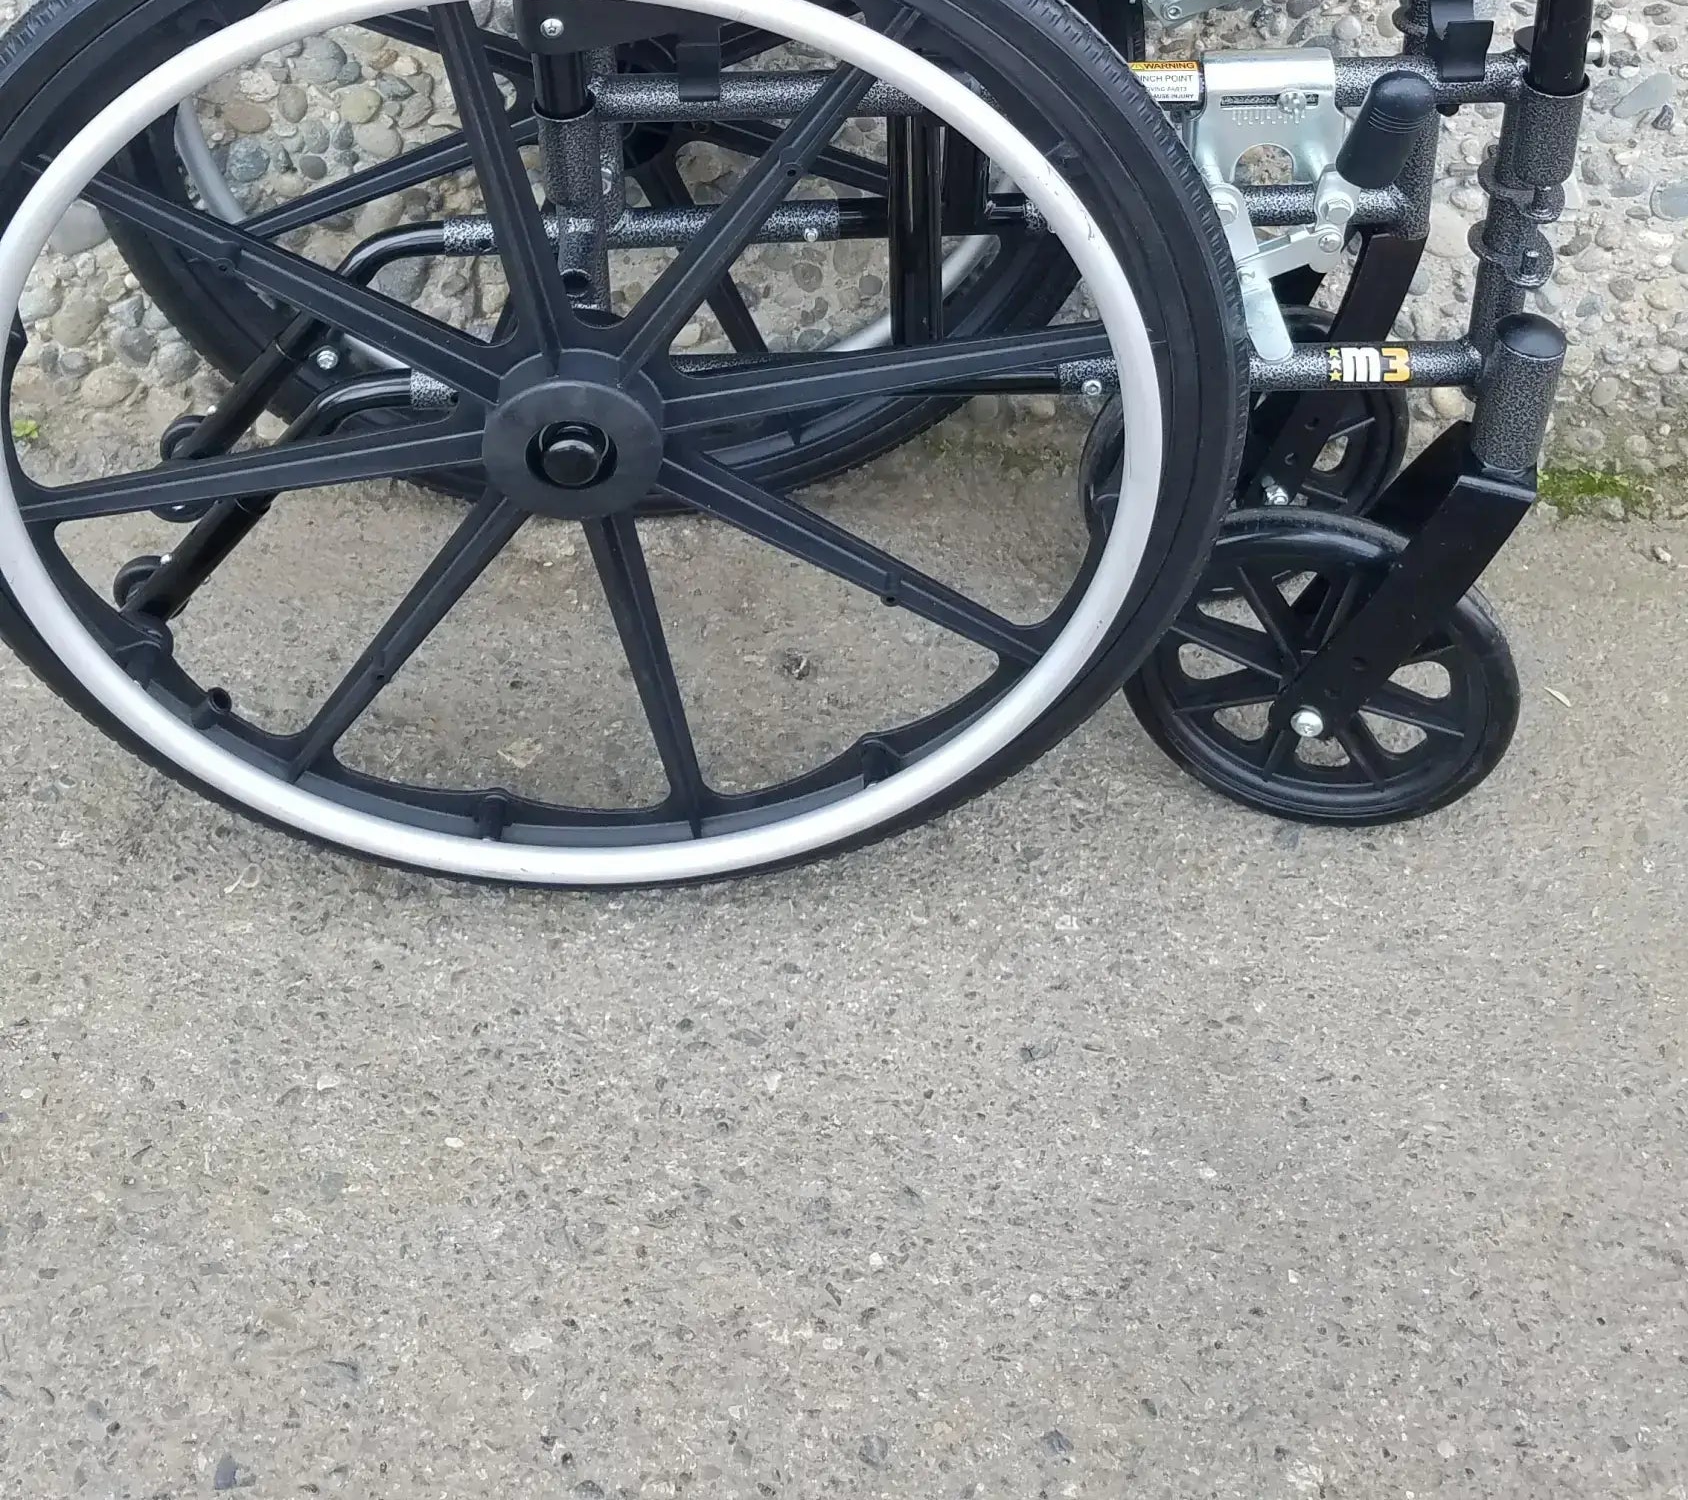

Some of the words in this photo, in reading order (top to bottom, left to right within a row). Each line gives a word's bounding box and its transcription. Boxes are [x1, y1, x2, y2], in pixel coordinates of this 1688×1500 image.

[1143, 62, 1195, 70] WARNING
[1138, 74, 1163, 83] INCH
[1165, 74, 1193, 83] POINT
